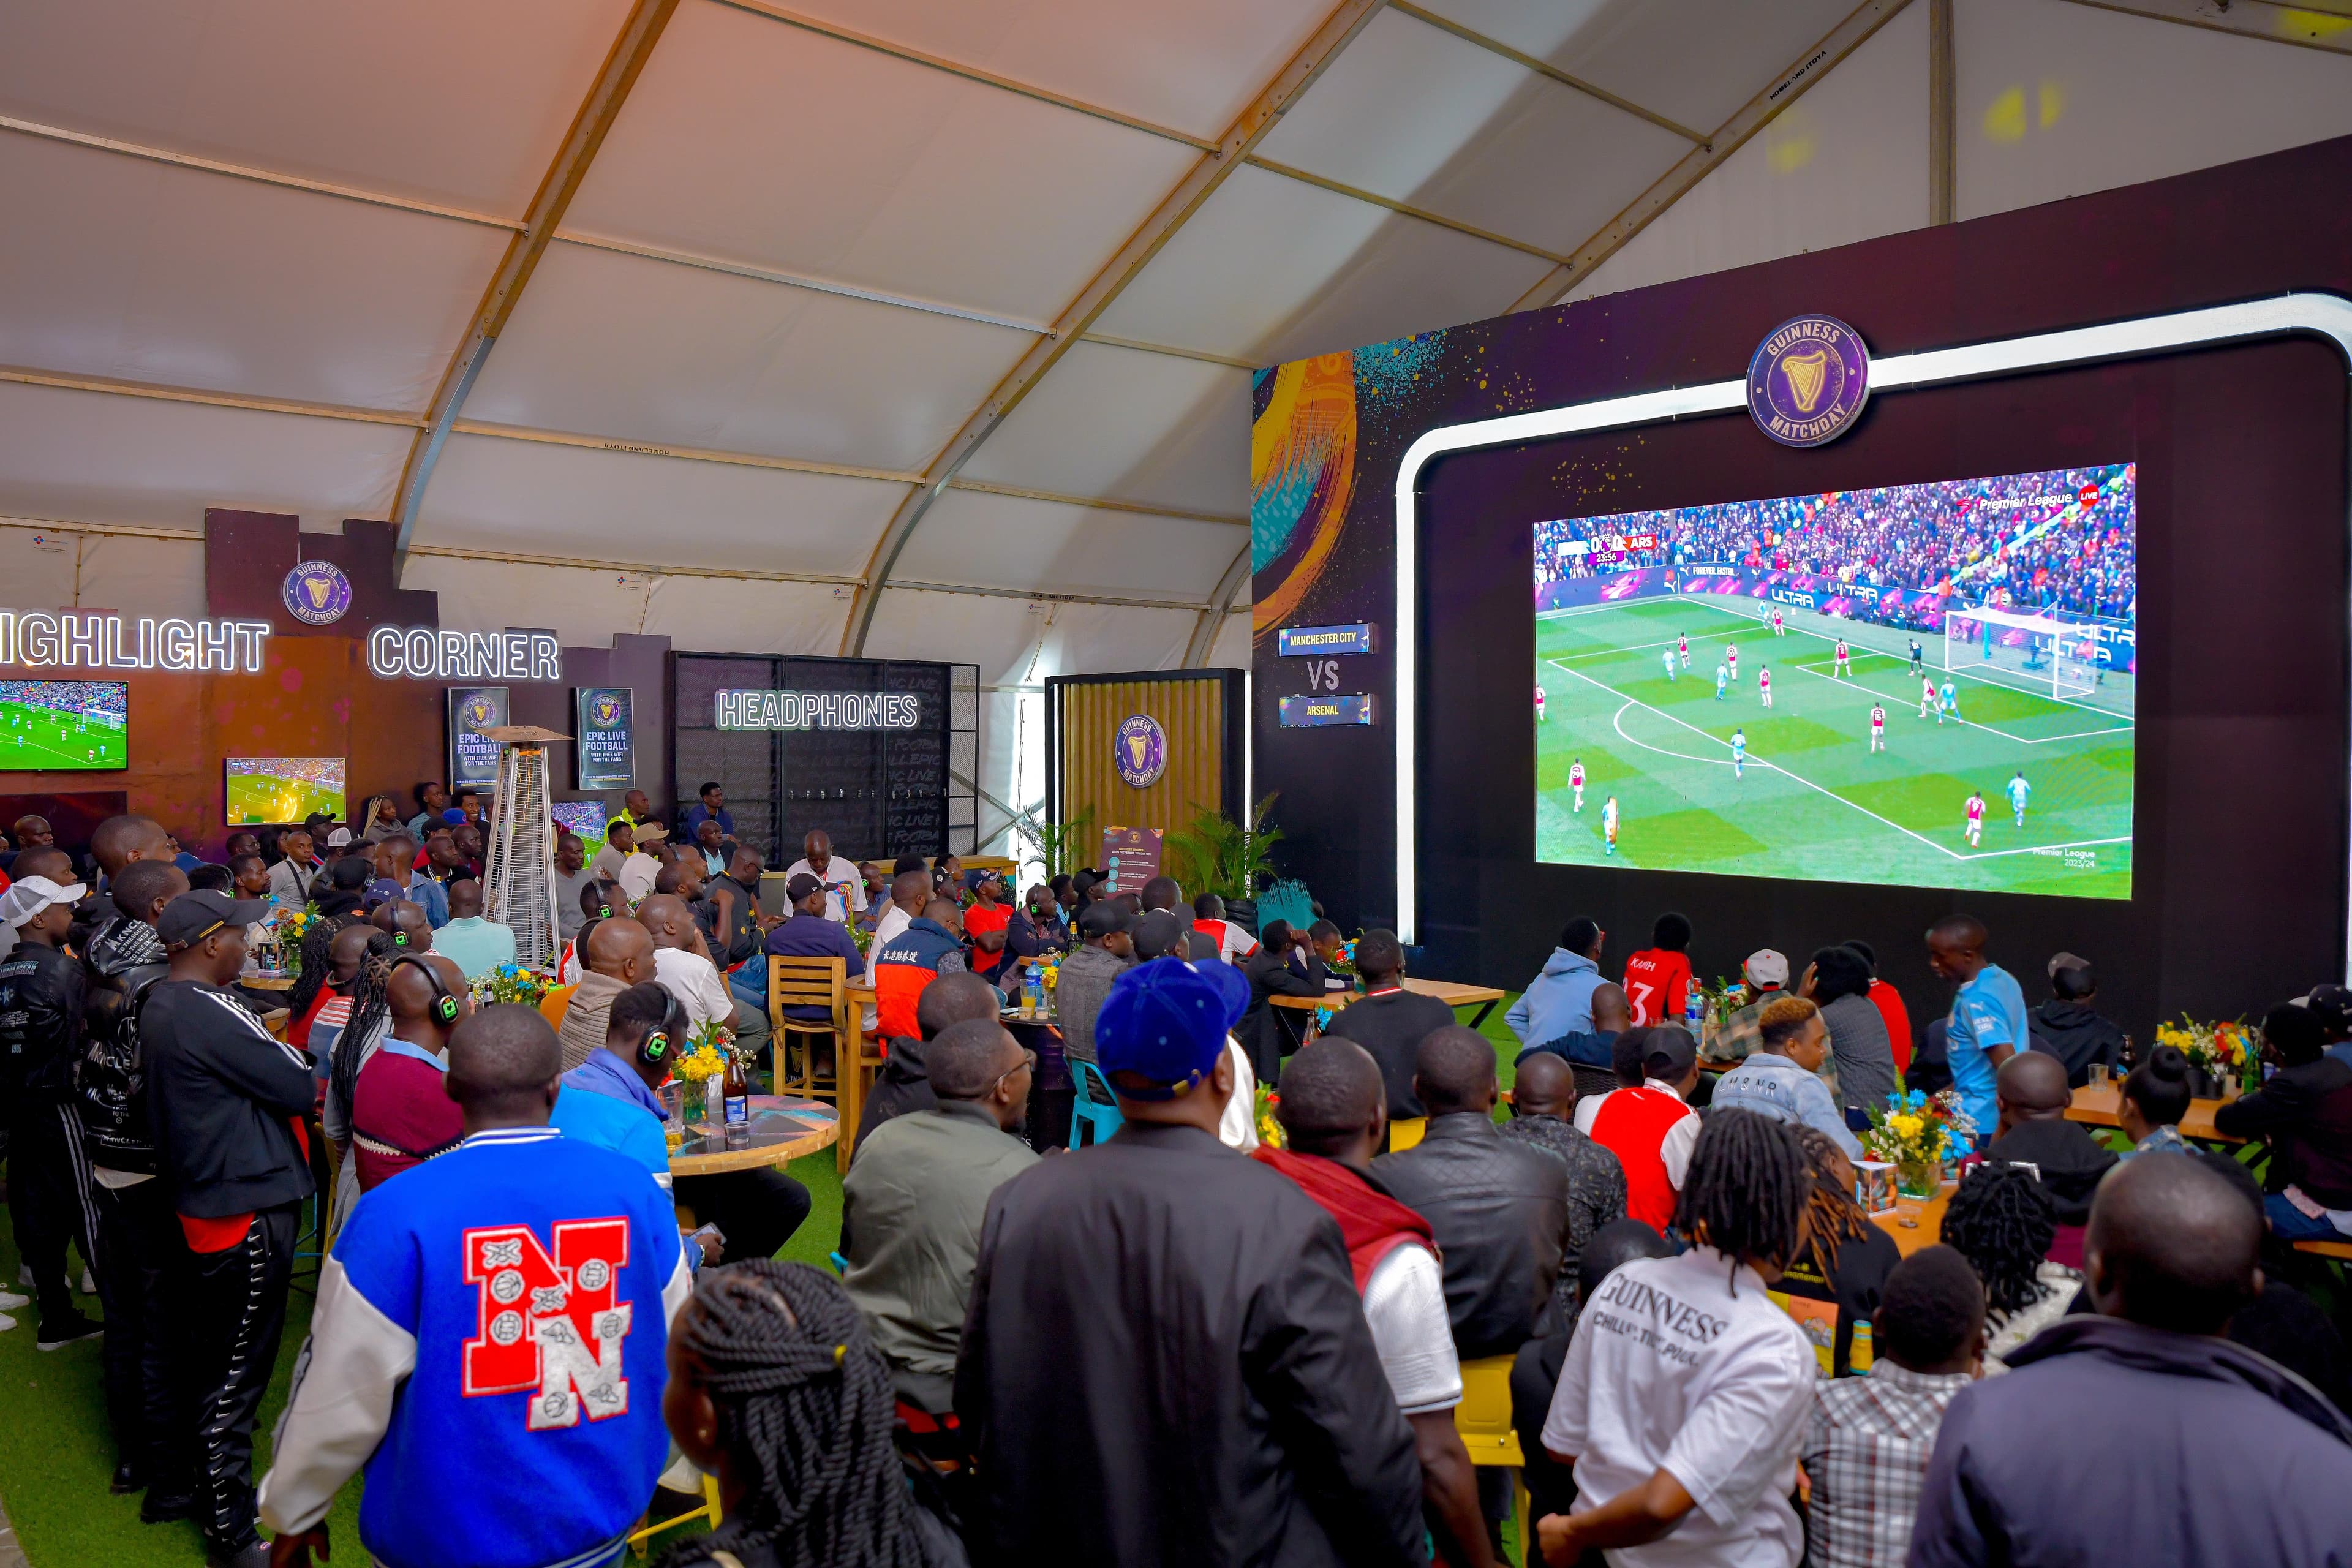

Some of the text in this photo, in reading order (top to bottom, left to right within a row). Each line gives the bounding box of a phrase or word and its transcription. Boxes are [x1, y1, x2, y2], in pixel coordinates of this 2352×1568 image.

[1770, 50, 1826, 100] HOMELAND ITOYA
[1766, 323, 1840, 356] GUINNESS
[1769, 402, 1845, 438] MATCHDAY
[1978, 491, 2098, 511] Premier League LIVE
[1591, 537, 1600, 553] 0
[1612, 534, 1623, 552] 0
[1630, 536, 1653, 549] ARS
[1596, 553, 1617, 563] 23:56
[297, 564, 338, 577] GUINNESS
[1771, 587, 1814, 608] ULTRA
[297, 606, 341, 621] MATCHDAY
[1289, 631, 1357, 646] MANCHESTER CITY
[372, 627, 560, 679] CORNER
[1306, 660, 1340, 690] VS
[719, 693, 918, 728] HEADPHONES
[1306, 705, 1339, 716] ARSENAL
[1875, 713, 1882, 722] 15
[1121, 718, 1152, 735] GUINNESS
[459, 734, 480, 744] EPIC
[587, 731, 626, 741] EPIC LIVE
[586, 741, 628, 751] FOOTBALL
[1123, 766, 1155, 783] MATCHDAY
[2064, 848, 2095, 859] League
[2064, 859, 2095, 868] 2023/24
[137, 930, 151, 942] WEST
[129, 953, 137, 962] TO
[1599, 1273, 1730, 1344] GUINNESS
